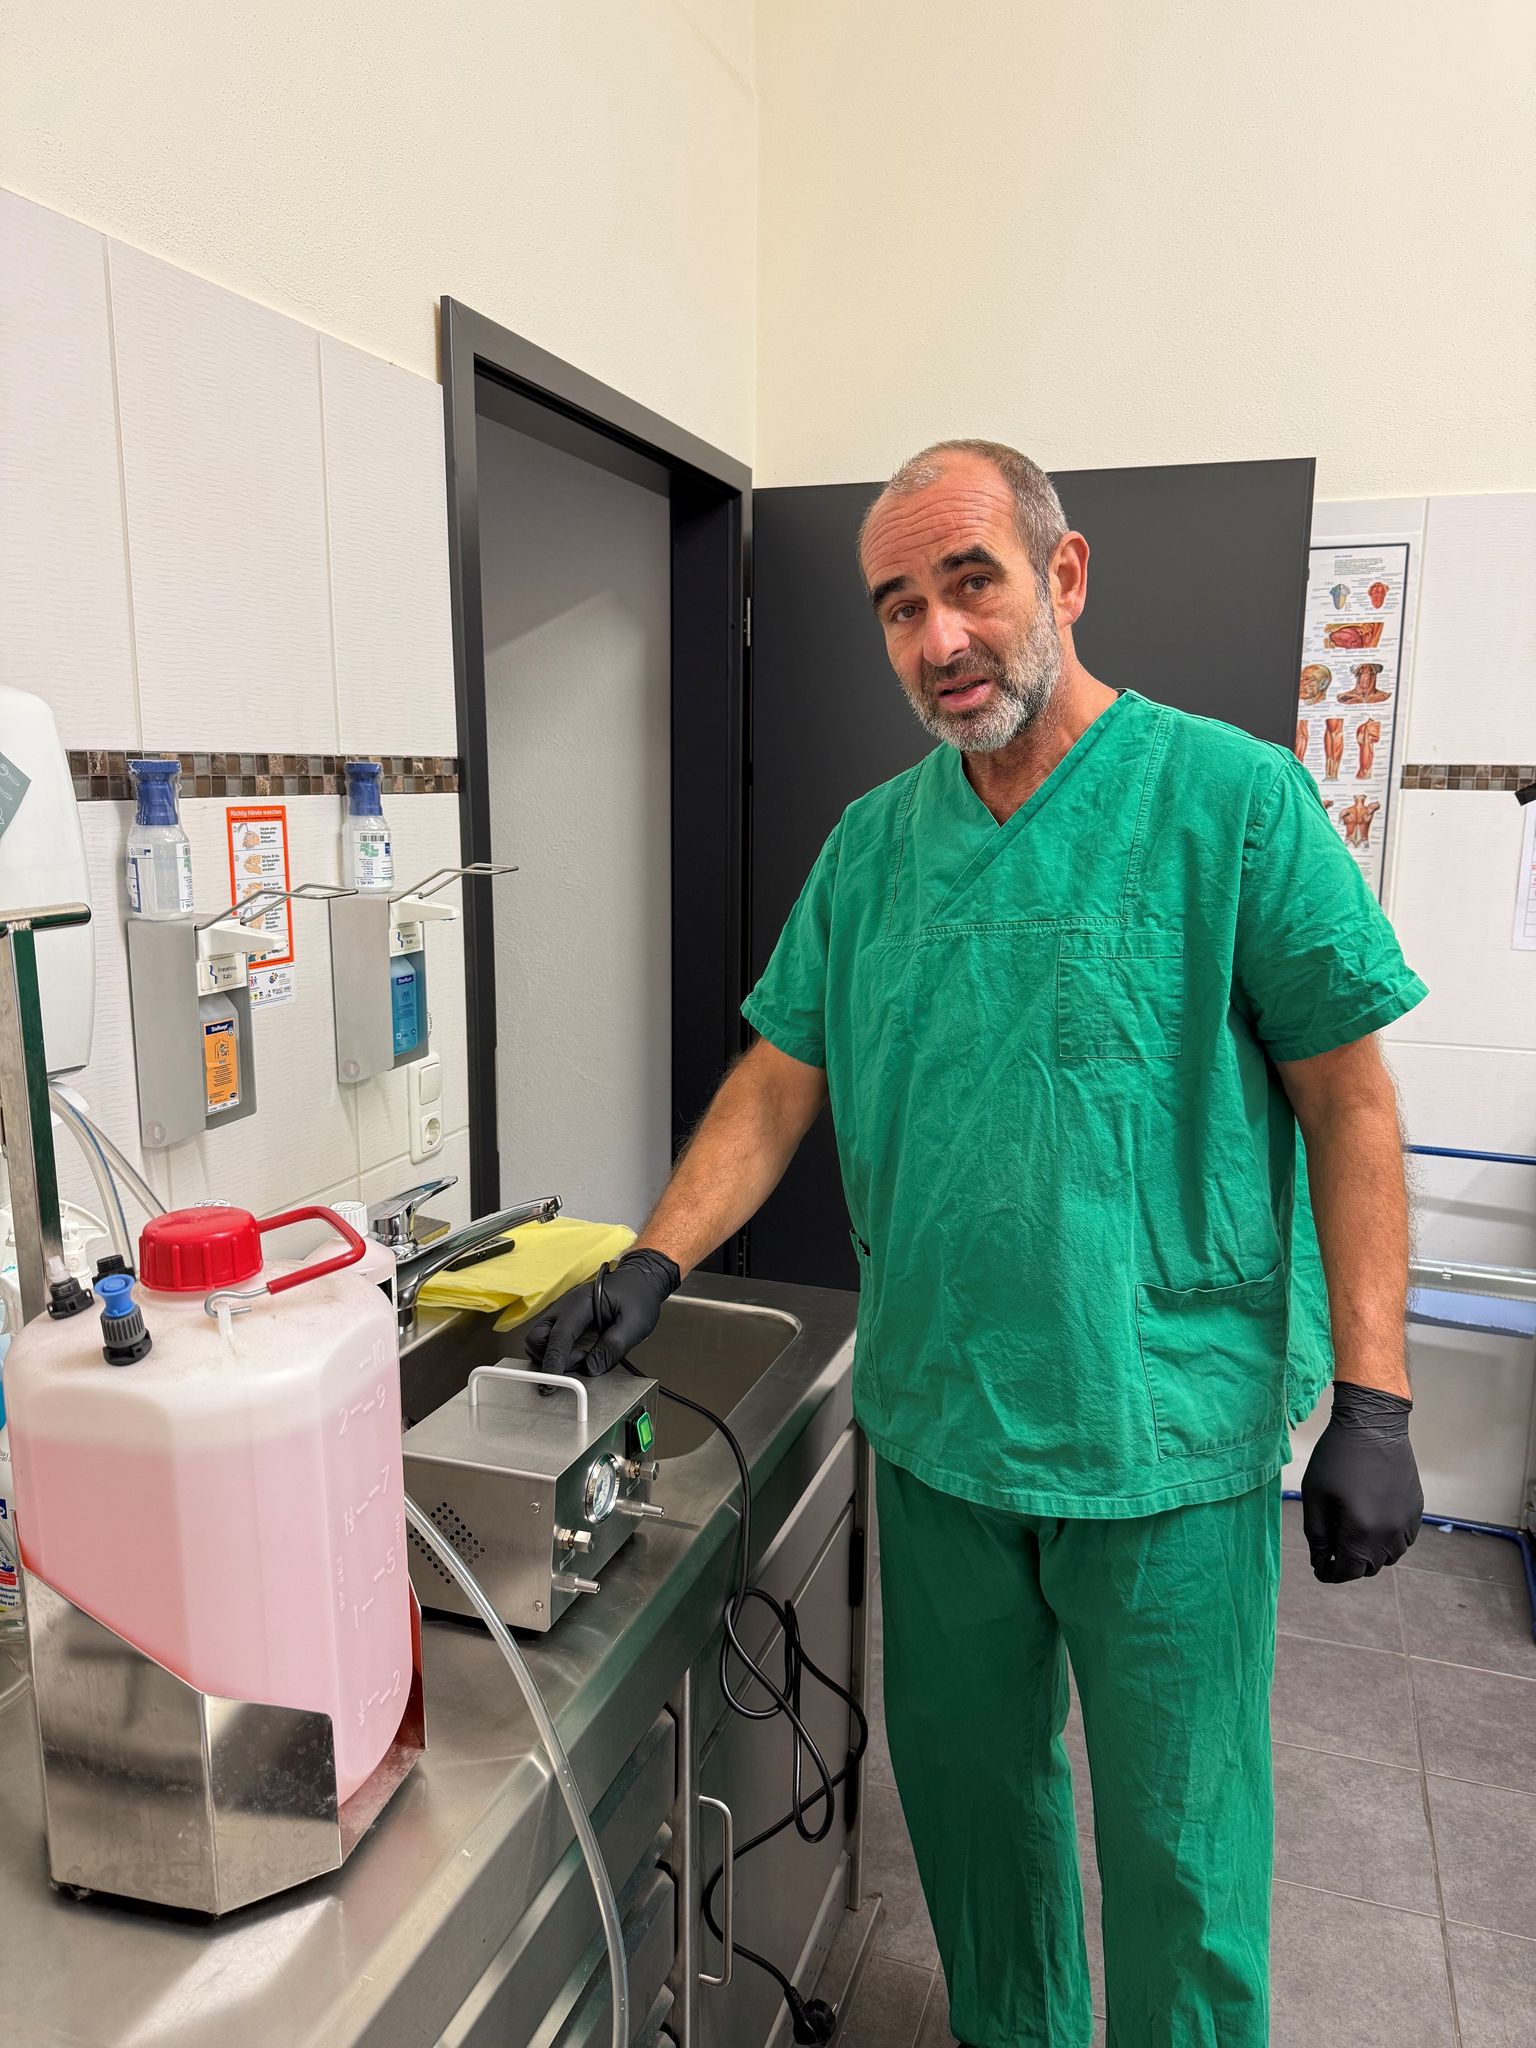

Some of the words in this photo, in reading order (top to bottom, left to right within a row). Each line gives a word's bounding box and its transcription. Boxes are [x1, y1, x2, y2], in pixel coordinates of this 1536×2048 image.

[376, 1383, 386, 1409] 9
[338, 1407, 349, 1435] 2
[381, 1464, 390, 1494] 7
[386, 1547, 396, 1574] 5
[393, 1669, 401, 1697] 2
